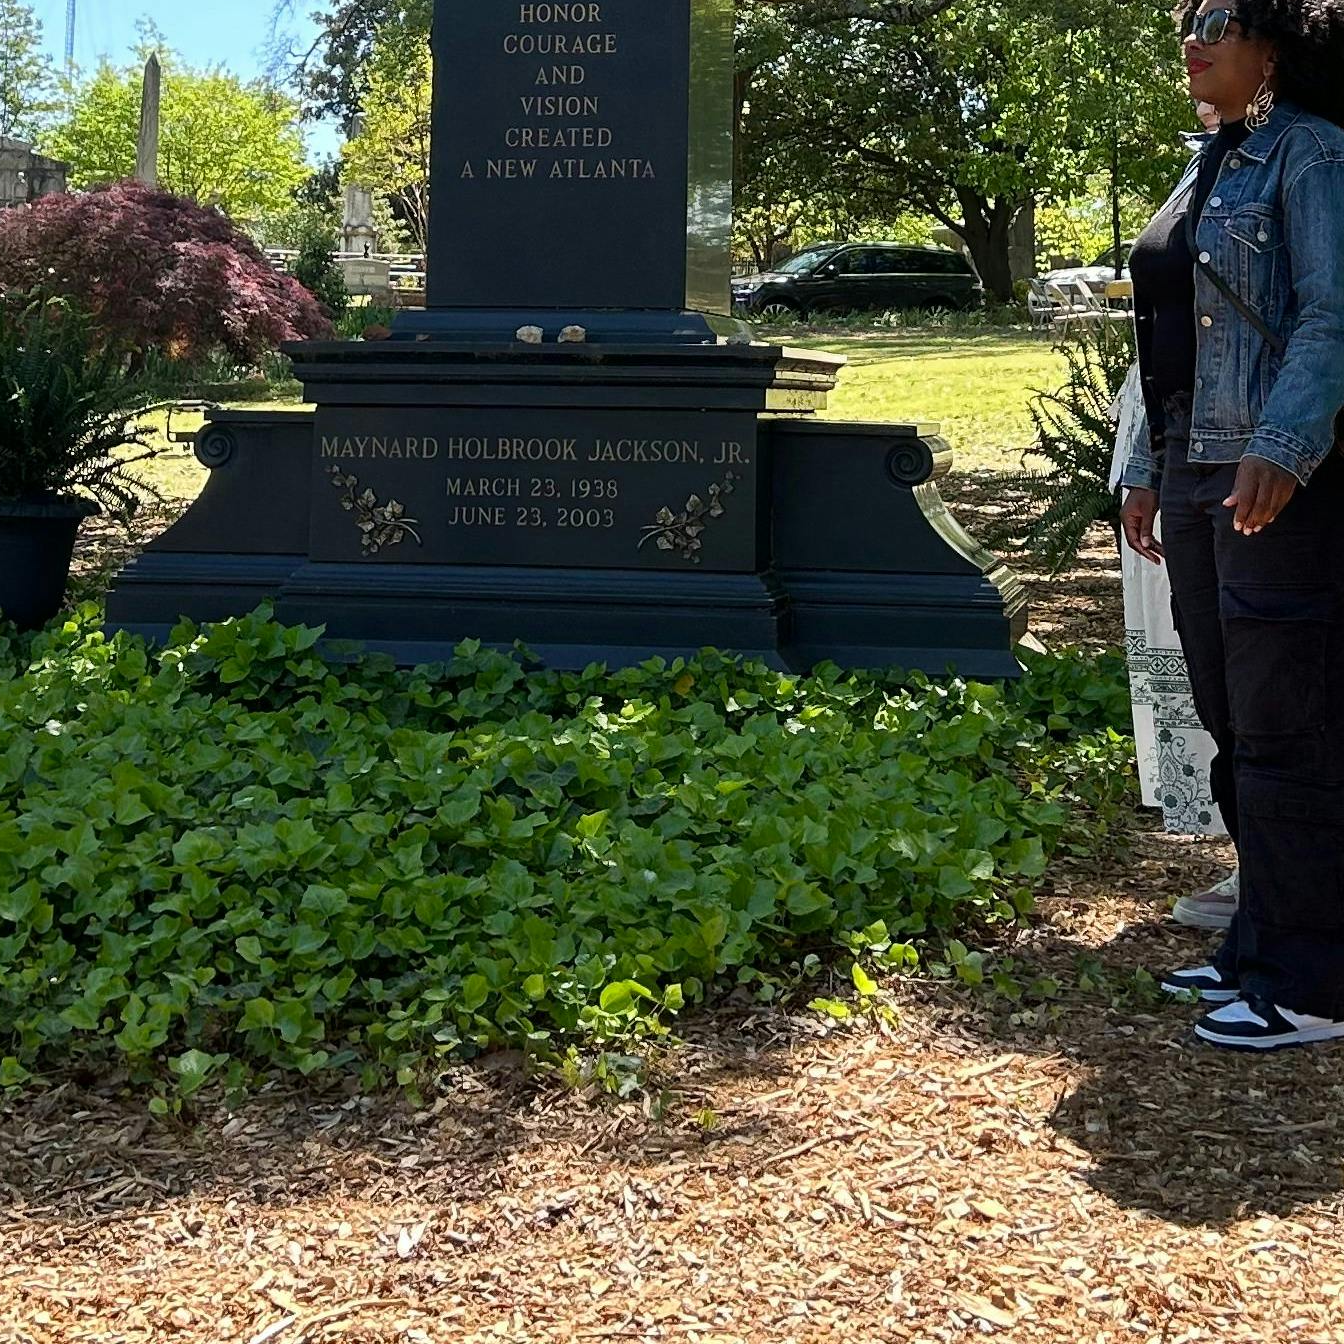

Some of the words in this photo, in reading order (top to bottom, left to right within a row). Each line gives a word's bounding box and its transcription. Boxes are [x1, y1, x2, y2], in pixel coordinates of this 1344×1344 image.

[519, 3, 602, 23] HONOR
[503, 34, 617, 54] COURAGE
[534, 65, 585, 85] AND
[520, 96, 598, 116] VISION
[505, 127, 612, 148] CREATED
[460, 160, 475, 179] A
[486, 159, 538, 179] NEW
[549, 158, 655, 179] ATLANTA
[320, 436, 438, 459] MAYNARD
[448, 437, 578, 461] HOLBROOK
[587, 439, 705, 464] JACKSON,
[713, 441, 750, 464] JR.
[446, 477, 520, 497] MARCH
[530, 477, 561, 499] 23,
[571, 479, 618, 499] 1938
[448, 506, 506, 526] JUNE
[516, 506, 547, 528] 23,
[556, 507, 614, 528] 2003
